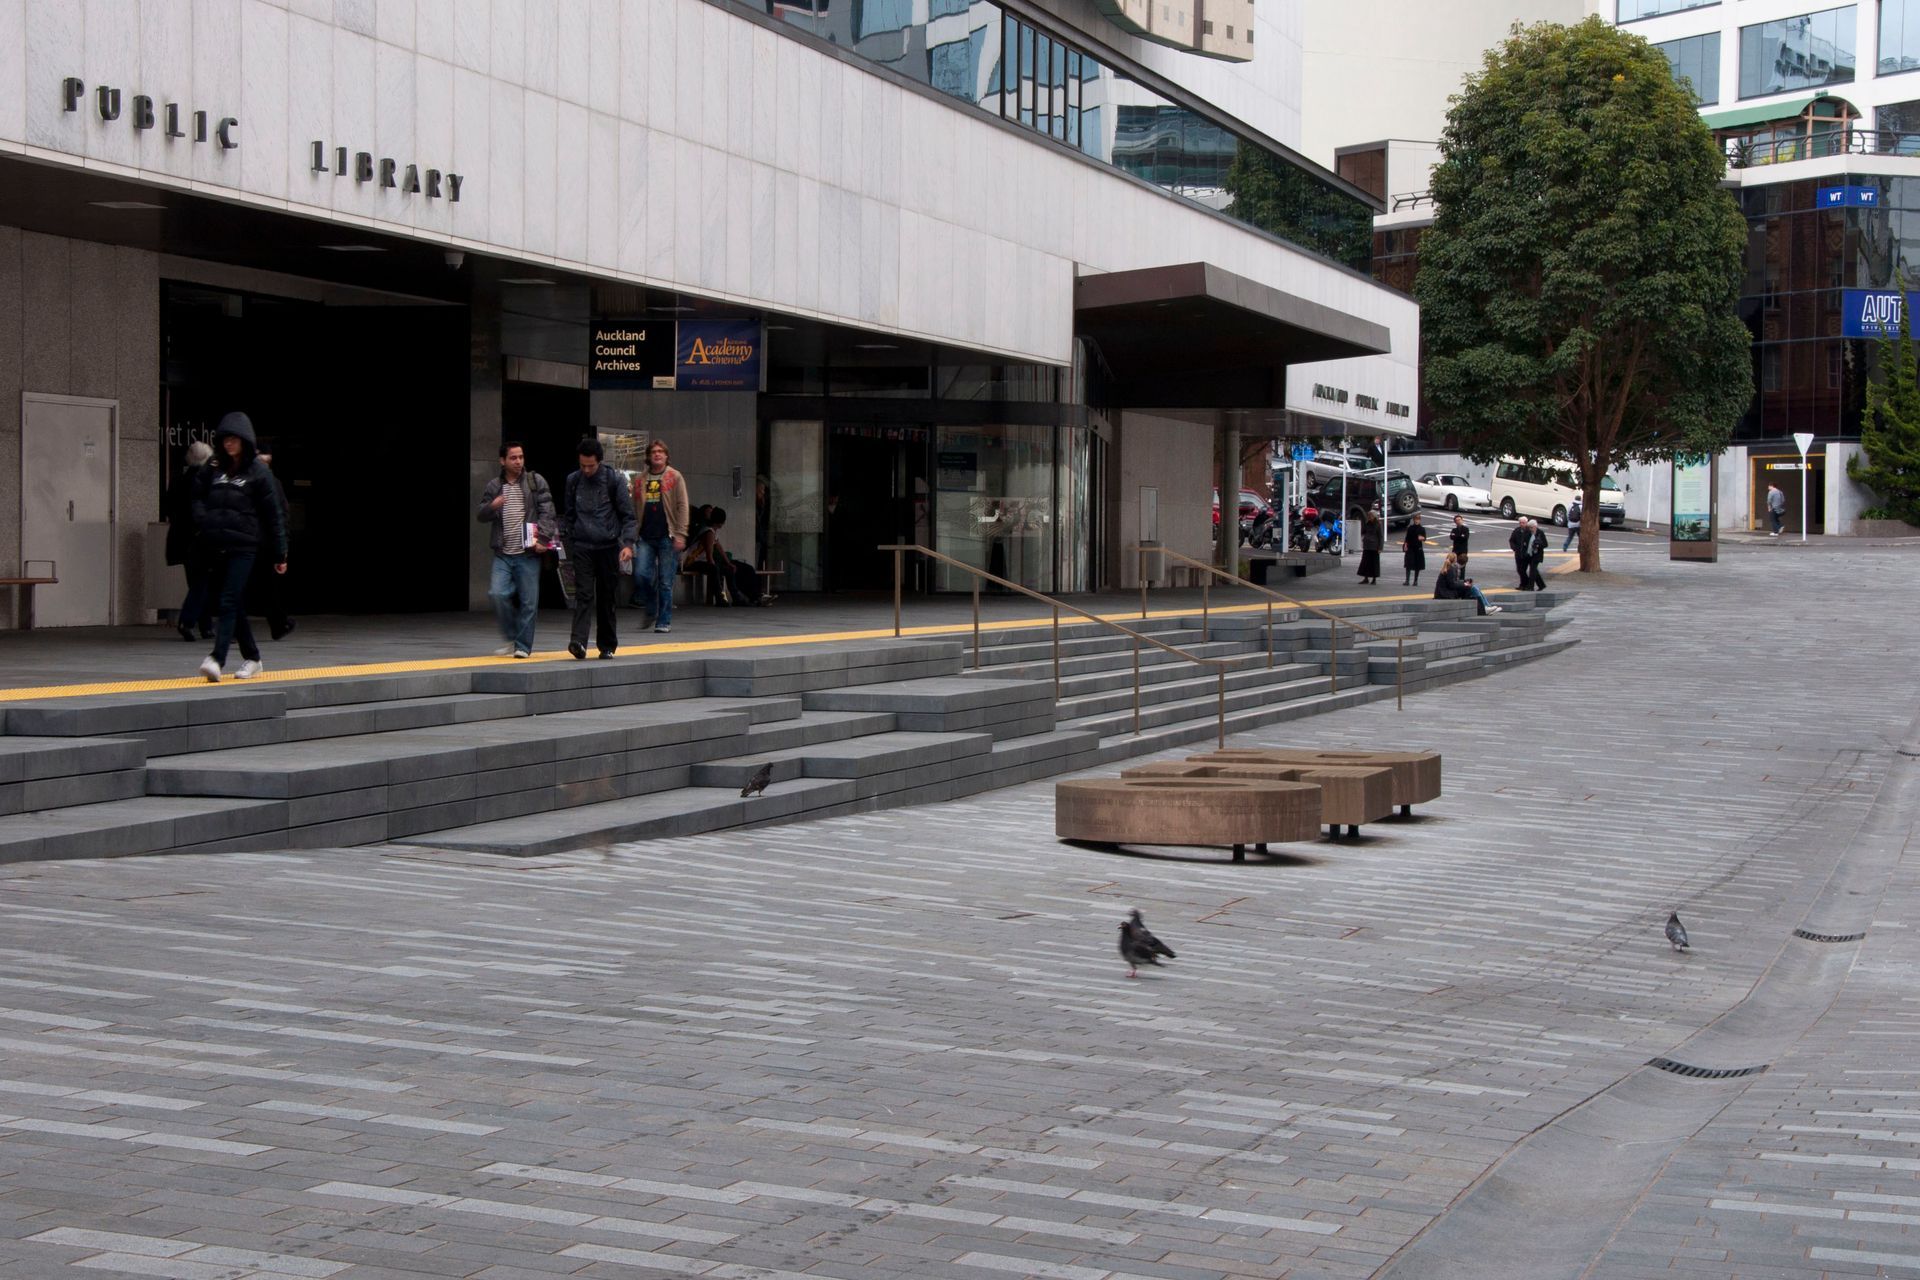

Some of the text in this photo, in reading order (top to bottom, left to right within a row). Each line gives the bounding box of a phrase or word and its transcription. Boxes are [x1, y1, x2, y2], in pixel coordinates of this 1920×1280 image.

[63, 77, 464, 202] PUBLIC LIBRARY
[1830, 192, 1842, 202] WT
[1860, 192, 1873, 201] WT
[1861, 295, 1902, 323] AUT
[595, 329, 646, 341] Auckland
[595, 344, 636, 356] Council
[684, 337, 753, 365] Academy
[594, 359, 641, 371] Archives
[711, 355, 743, 365] cinema
